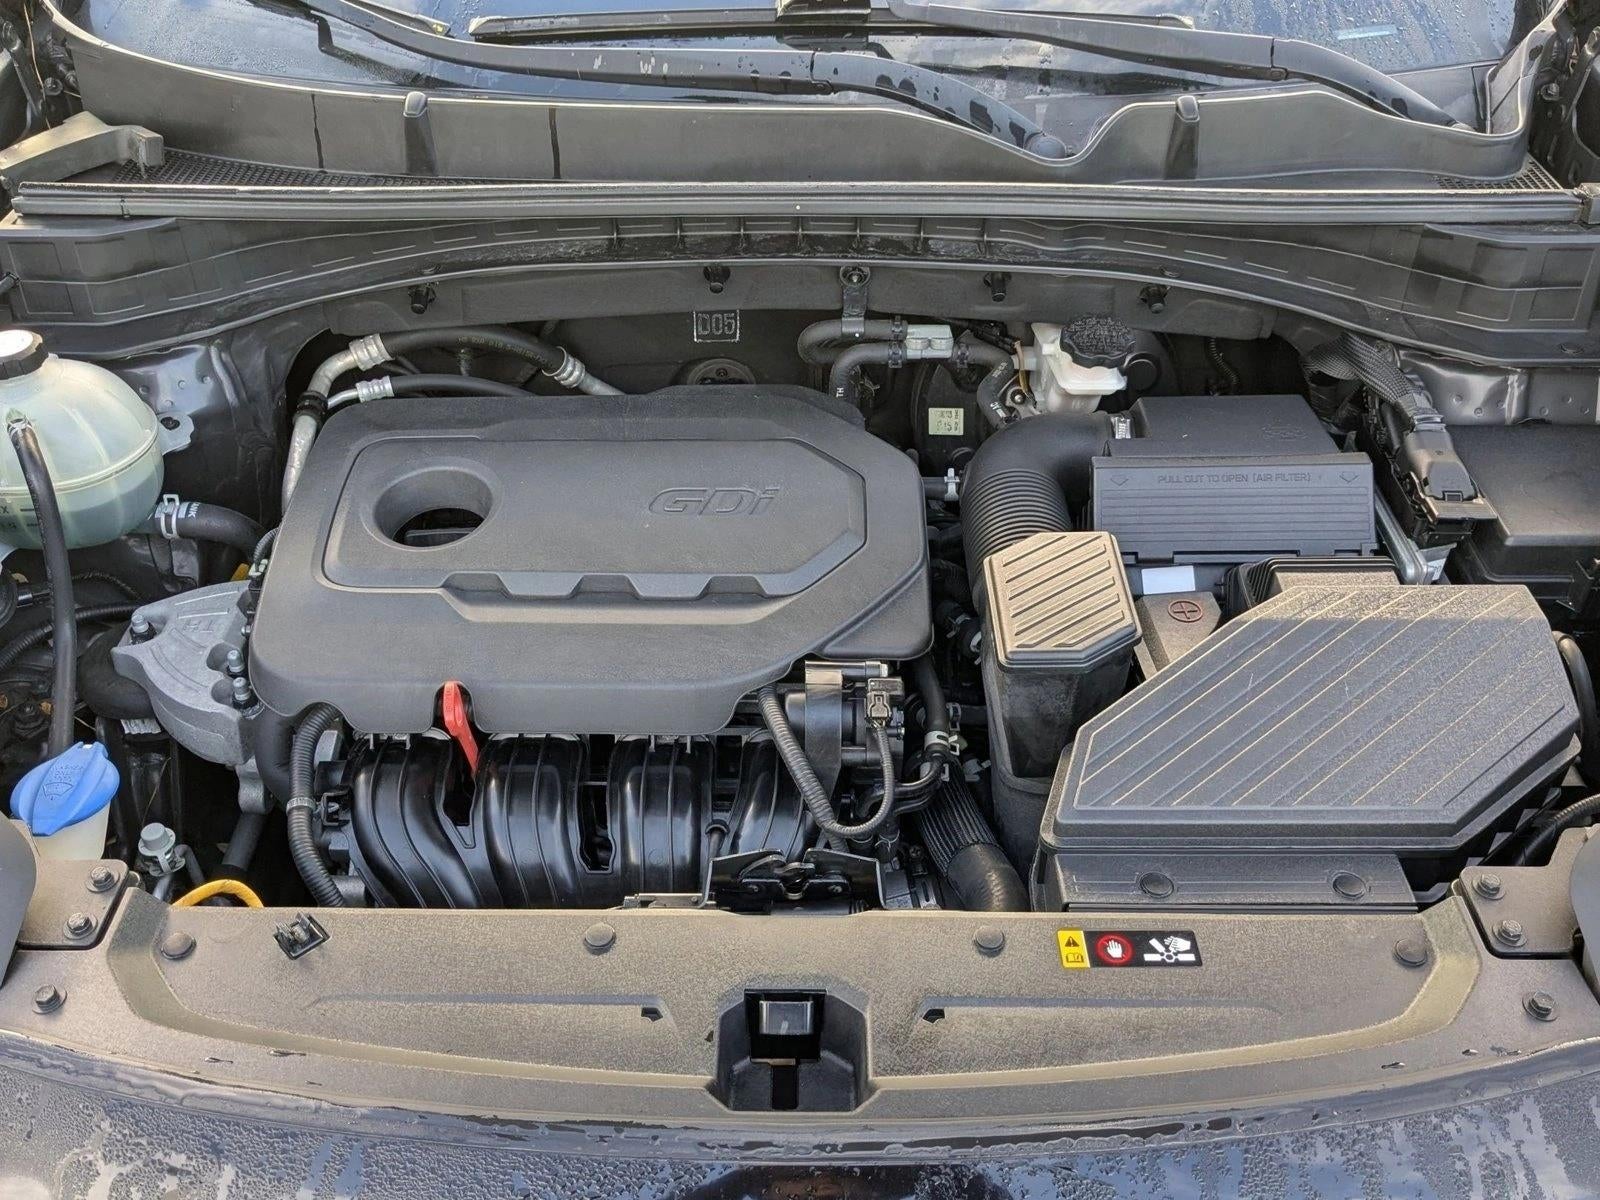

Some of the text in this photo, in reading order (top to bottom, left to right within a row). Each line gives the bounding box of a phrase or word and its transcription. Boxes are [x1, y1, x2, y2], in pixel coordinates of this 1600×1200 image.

[1157, 474, 1183, 484] PULL
[1184, 474, 1205, 483] OUT
[1206, 474, 1220, 483] TO
[1221, 473, 1248, 483] OPEN
